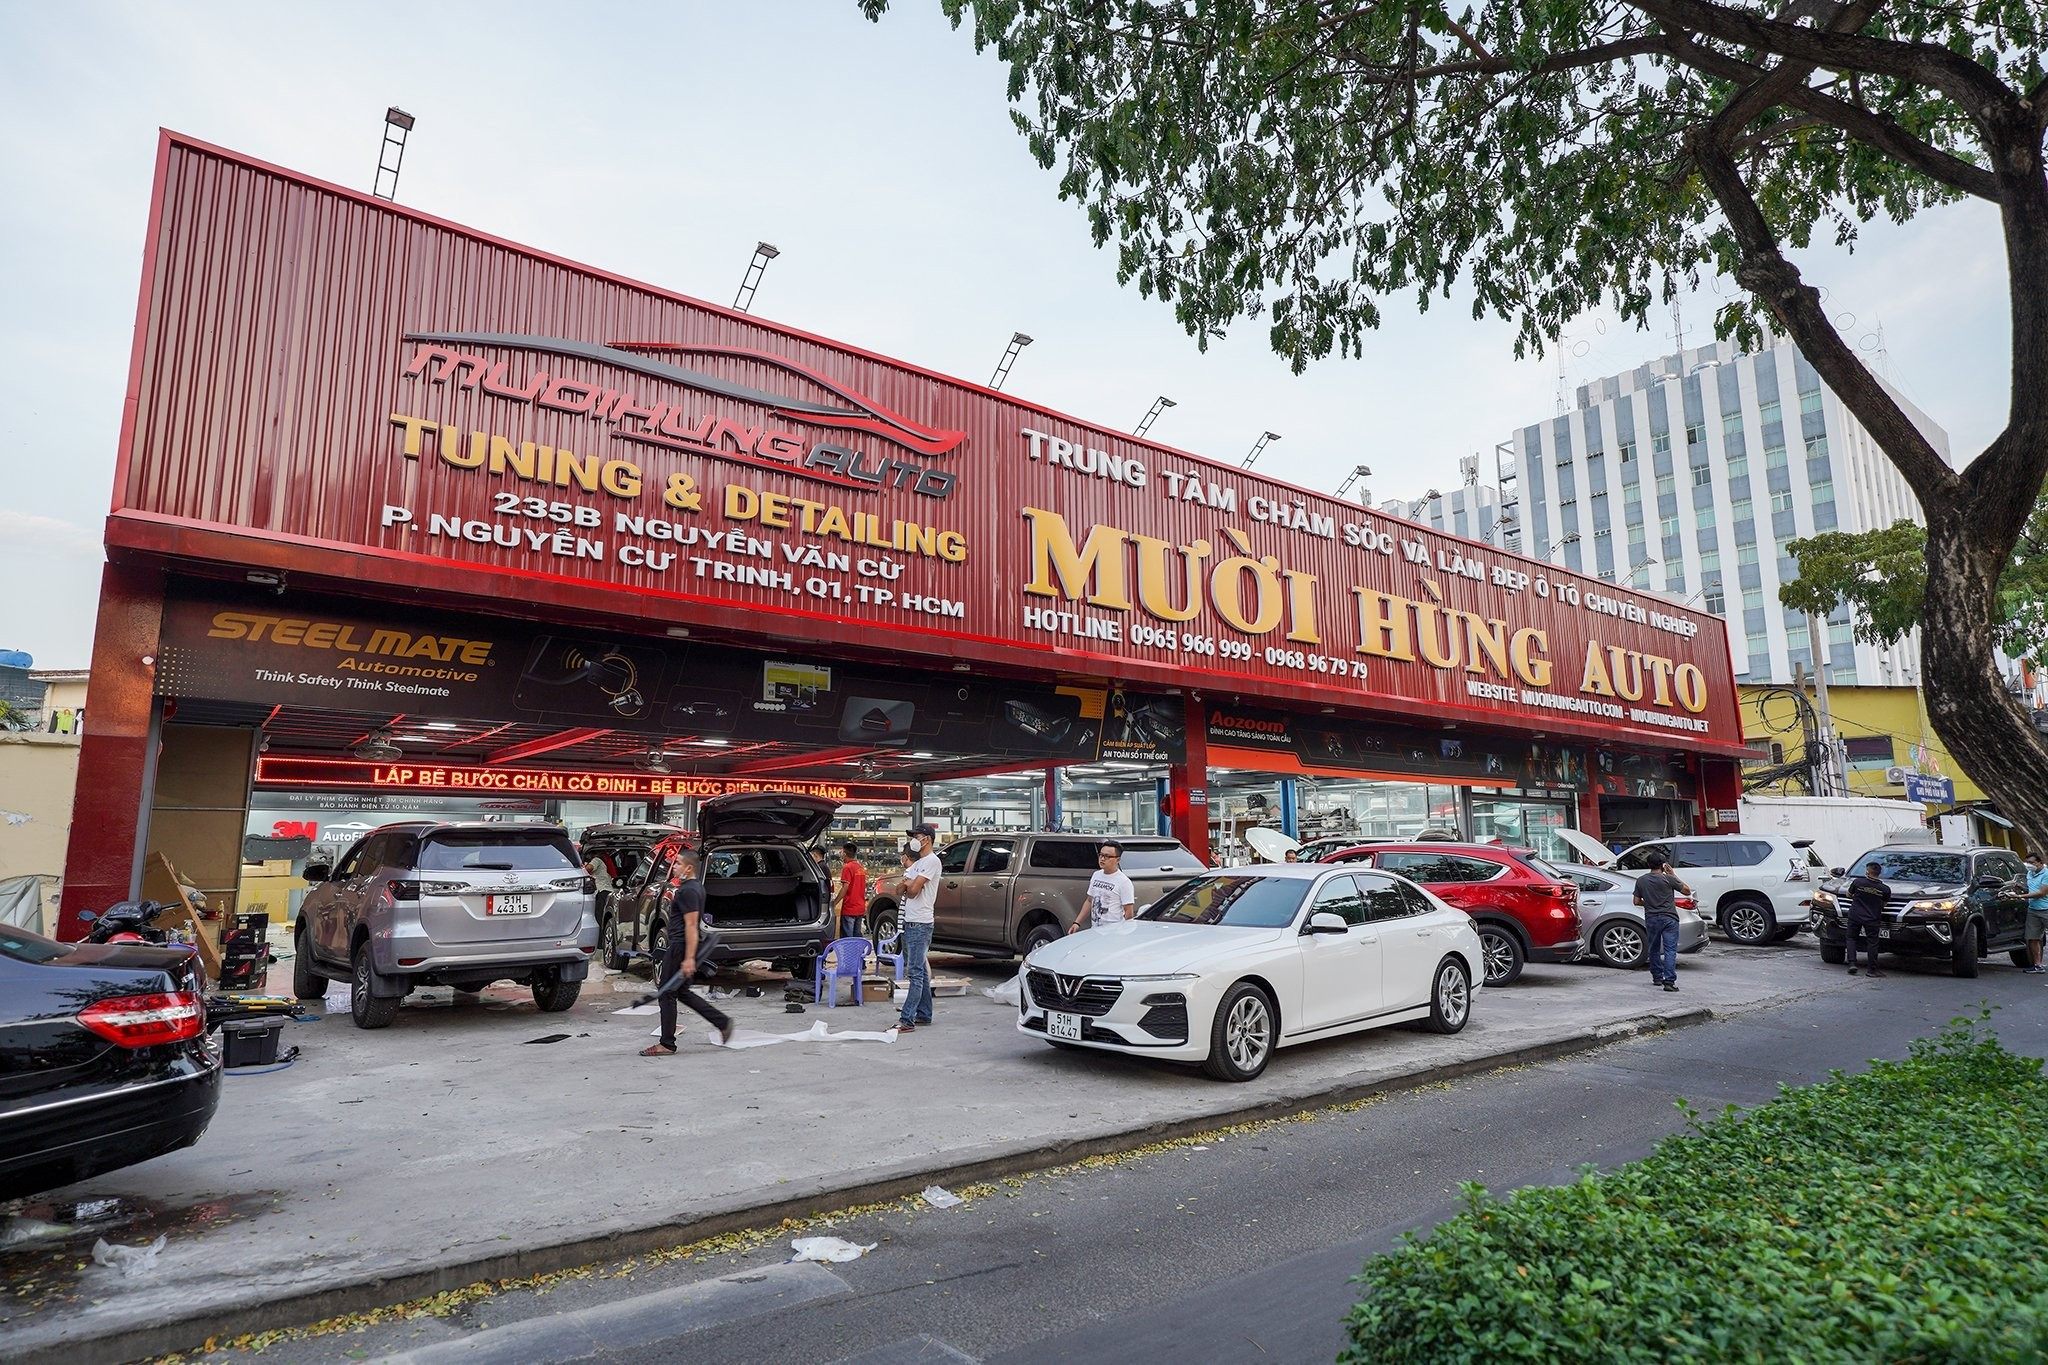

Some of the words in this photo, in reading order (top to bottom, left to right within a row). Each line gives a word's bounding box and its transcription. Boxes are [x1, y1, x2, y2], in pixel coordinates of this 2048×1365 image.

[390, 413, 642, 498] TUNING
[664, 472, 703, 511] &
[724, 484, 967, 562] DETAILING
[494, 492, 601, 527] 235B
[615, 512, 772, 559] NGUYỄN
[781, 542, 850, 573] VĂN
[857, 556, 905, 580] CỪ
[1021, 428, 1146, 487] TRUNG
[1162, 470, 1235, 513] TÂM
[1248, 496, 1335, 539] CHĂM
[1343, 521, 1393, 556] SỐC
[1401, 536, 1432, 567] VÀ
[1438, 548, 1484, 582] LÀM
[1491, 566, 1530, 595] ĐẸP
[1535, 574, 1549, 598] Ô
[1553, 583, 1579, 606] TÔ
[1584, 592, 1647, 625] CHUYÊN
[1650, 611, 1698, 641] NGHIỆP
[382, 504, 418, 531] P.
[430, 513, 604, 560] NGUYỄN
[618, 545, 677, 571] CƯ
[854, 584, 897, 608] TP.
[901, 592, 965, 618] HCM
[1022, 506, 1321, 645] MƯỜI
[1352, 577, 1553, 687] HÙNG
[1579, 640, 1708, 714] AUTO
[1023, 606, 1123, 643] HOTLINE:
[1130, 624, 1178, 650] 0965
[1181, 633, 1215, 656] 966
[1218, 639, 1252, 661] 999
[1265, 647, 1305, 670] 0968
[336, 657, 478, 682] Automotive
[255, 669, 294, 684] Think
[298, 673, 343, 689] Safety
[346, 678, 382, 691] Think
[385, 681, 450, 697] Steelmate
[1466, 680, 1518, 703] WEBSITE:
[1210, 711, 1285, 733] Aozoom
[1224, 729, 1236, 737] CAO
[1103, 750, 1112, 758] AN
[1113, 749, 1130, 758] TOÀN
[1131, 748, 1139, 759] SỐ
[1143, 749, 1155, 760] THẾ
[451, 770, 508, 788] BƯỚC
[512, 774, 563, 790] CHÂN
[676, 779, 722, 796] BƯỚC
[809, 783, 847, 798] HÃNG
[271, 820, 318, 842] 3M
[497, 904, 528, 913] 443.15
[504, 895, 522, 904] 51H
[1050, 1024, 1078, 1038] 814.47
[1057, 1013, 1072, 1026] 51H
